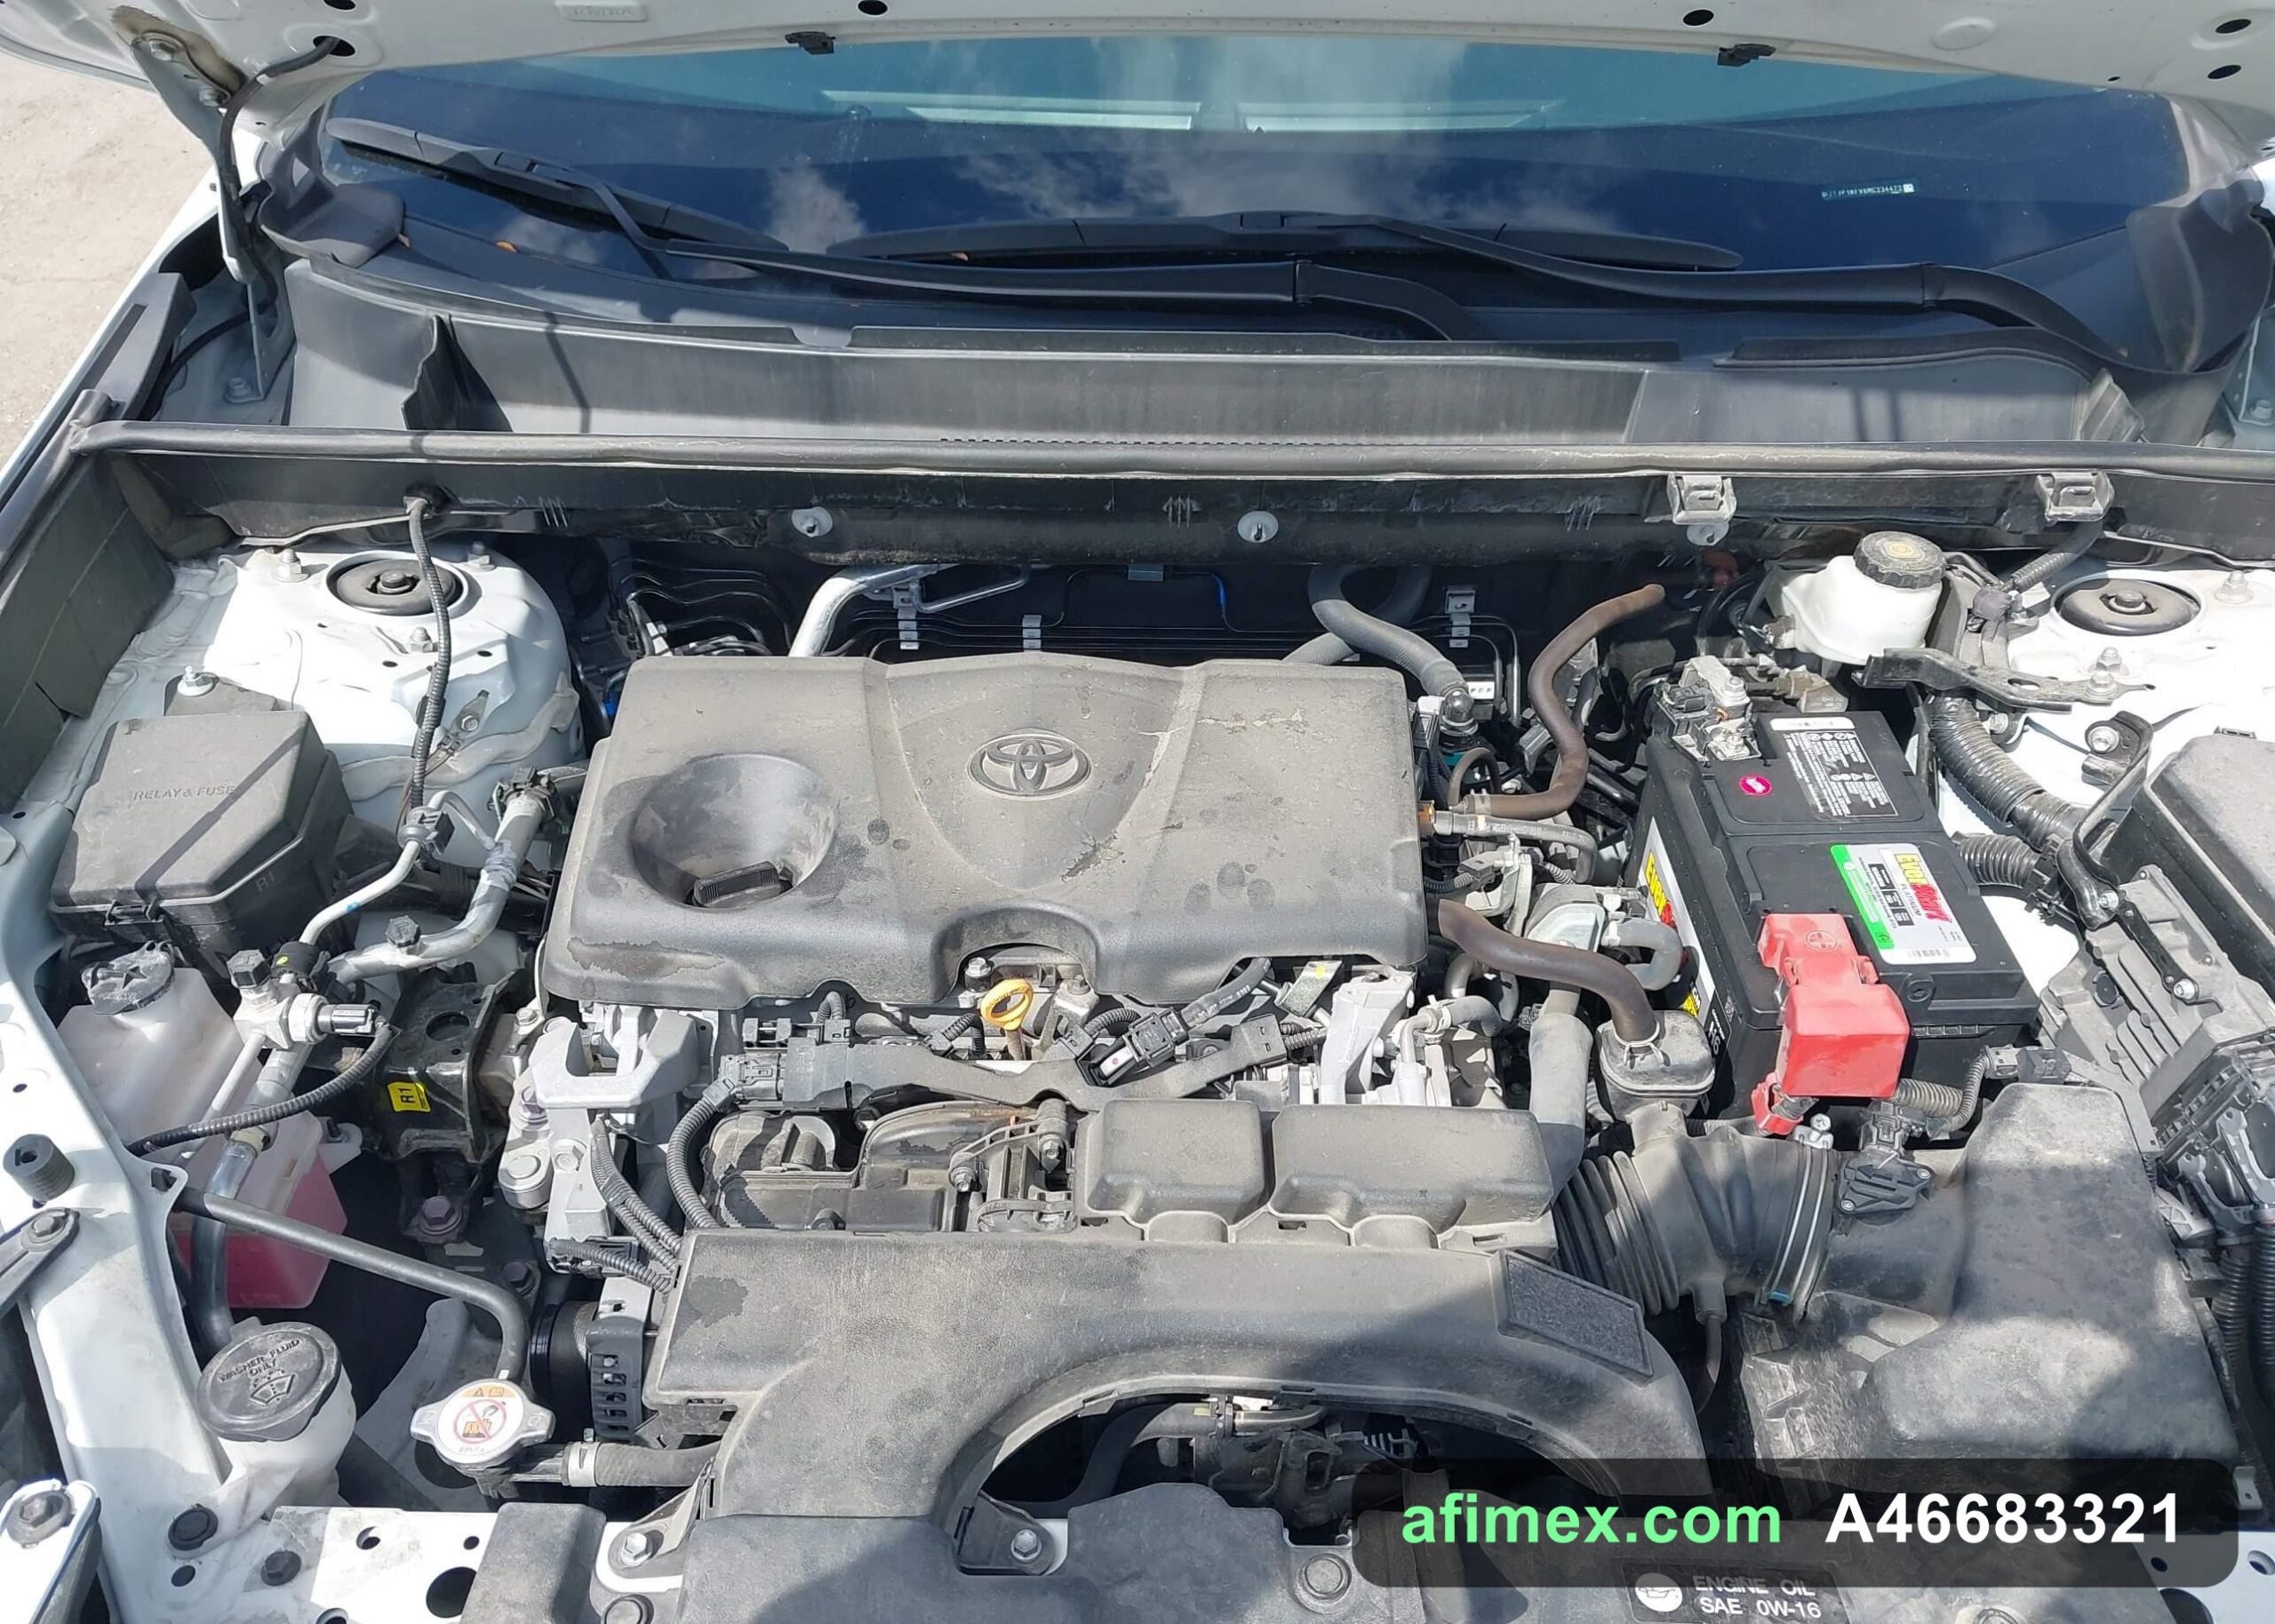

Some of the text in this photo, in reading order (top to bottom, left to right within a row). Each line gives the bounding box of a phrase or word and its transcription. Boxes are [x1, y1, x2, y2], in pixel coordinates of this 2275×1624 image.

[133, 785, 235, 800] RELAY & FUSE
[1894, 854, 1952, 921] EverStart
[1900, 883, 1922, 916] PLATINUM
[397, 1088, 417, 1103] R1
[218, 1339, 301, 1382] WASHER FLUID
[250, 1358, 277, 1375] ONLY
[1693, 1575, 1816, 1596] ENGINE OIL
[1699, 1597, 1822, 1620] SAE 0W-16
